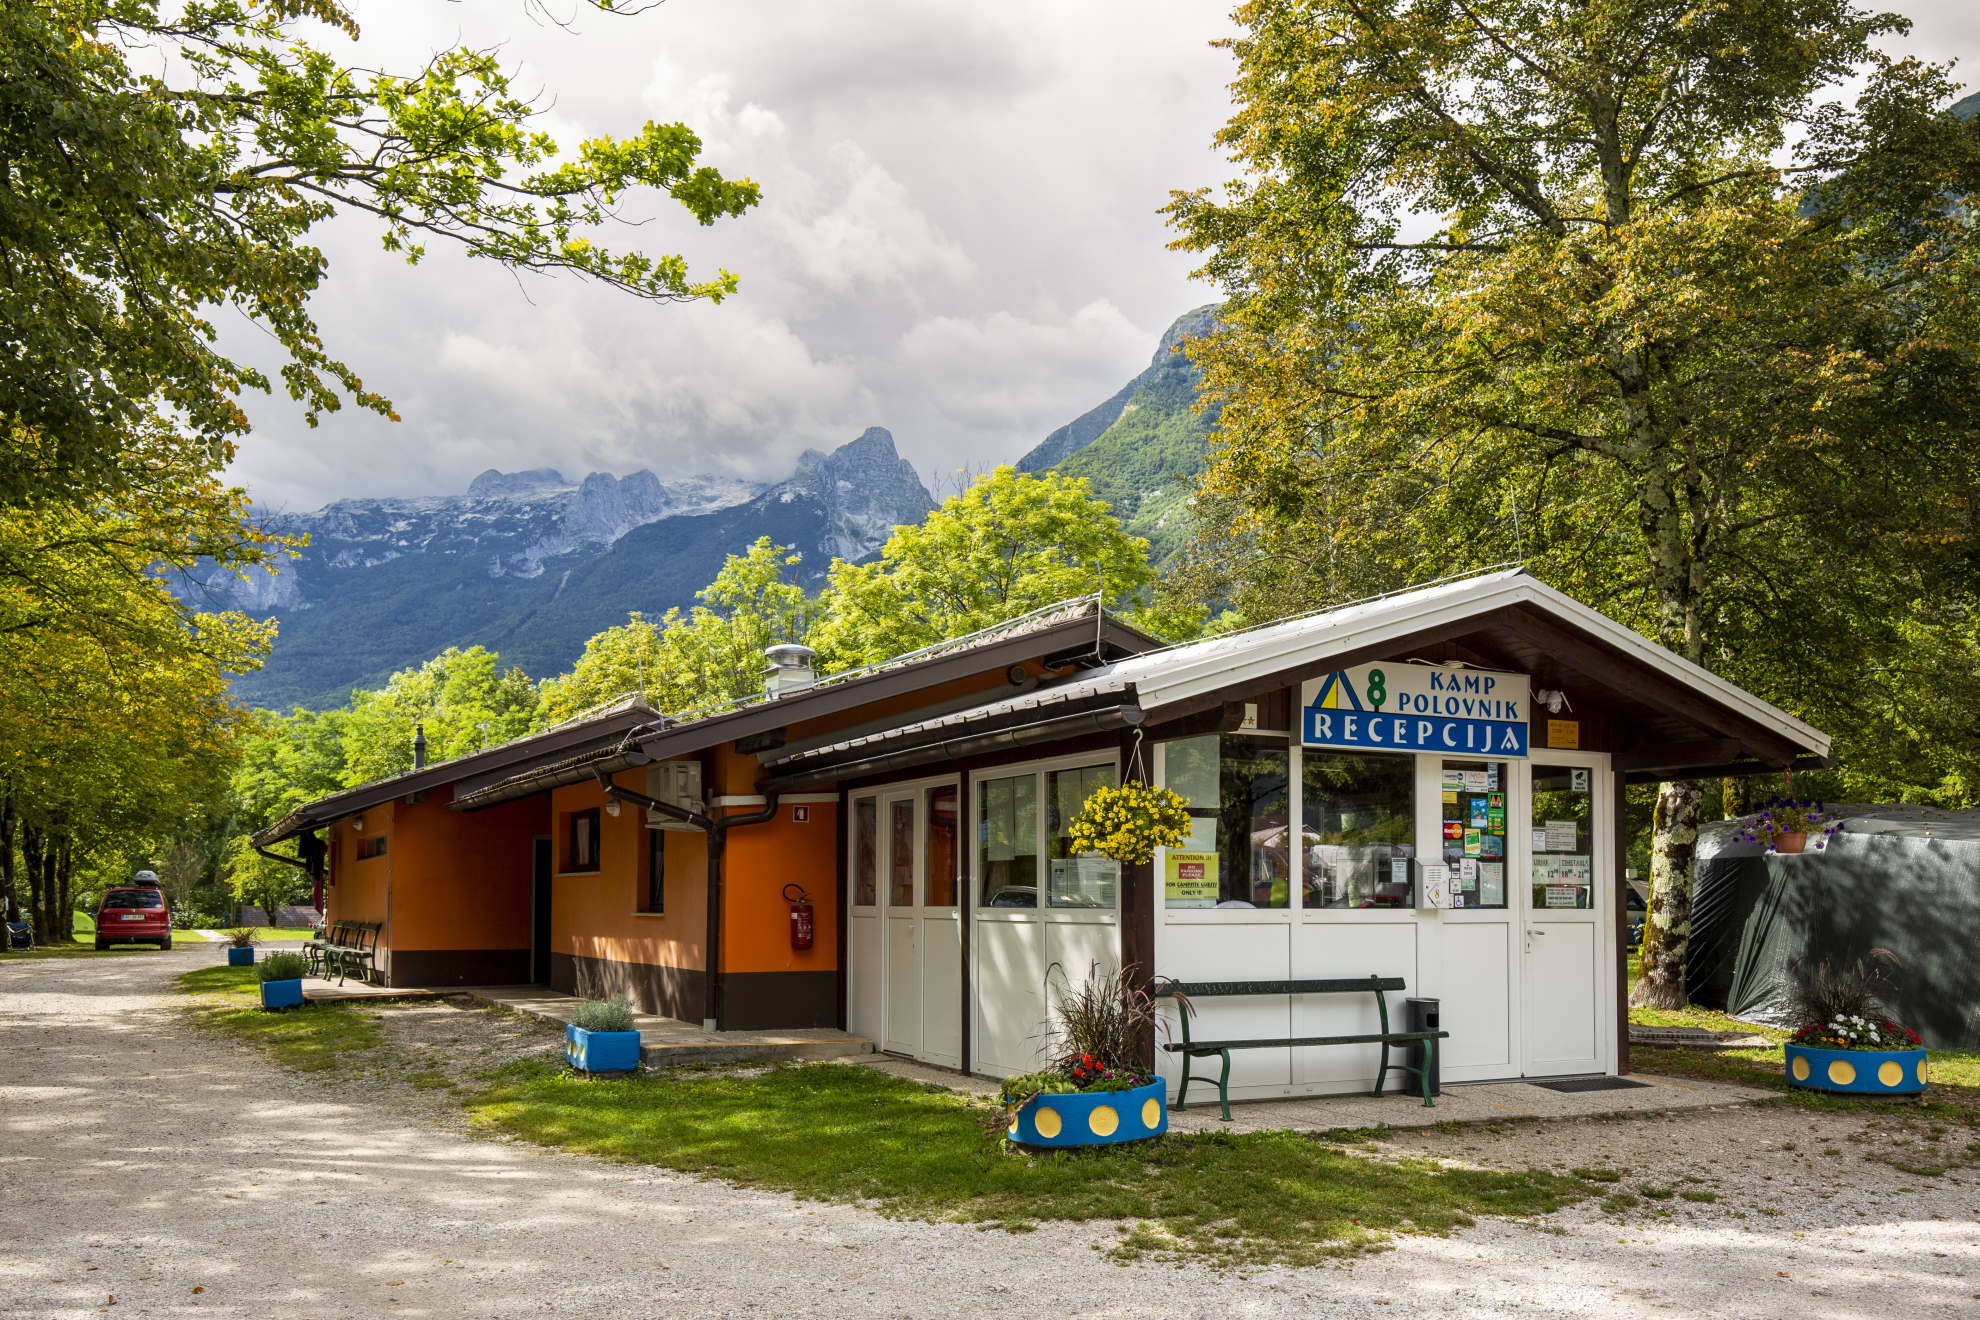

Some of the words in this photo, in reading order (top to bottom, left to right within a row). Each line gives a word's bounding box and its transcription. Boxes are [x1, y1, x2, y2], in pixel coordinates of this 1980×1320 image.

[1430, 671, 1496, 695] KAMP
[1399, 692, 1519, 720] POLOVNIK
[1314, 713, 1520, 753] RECEPCIJA
